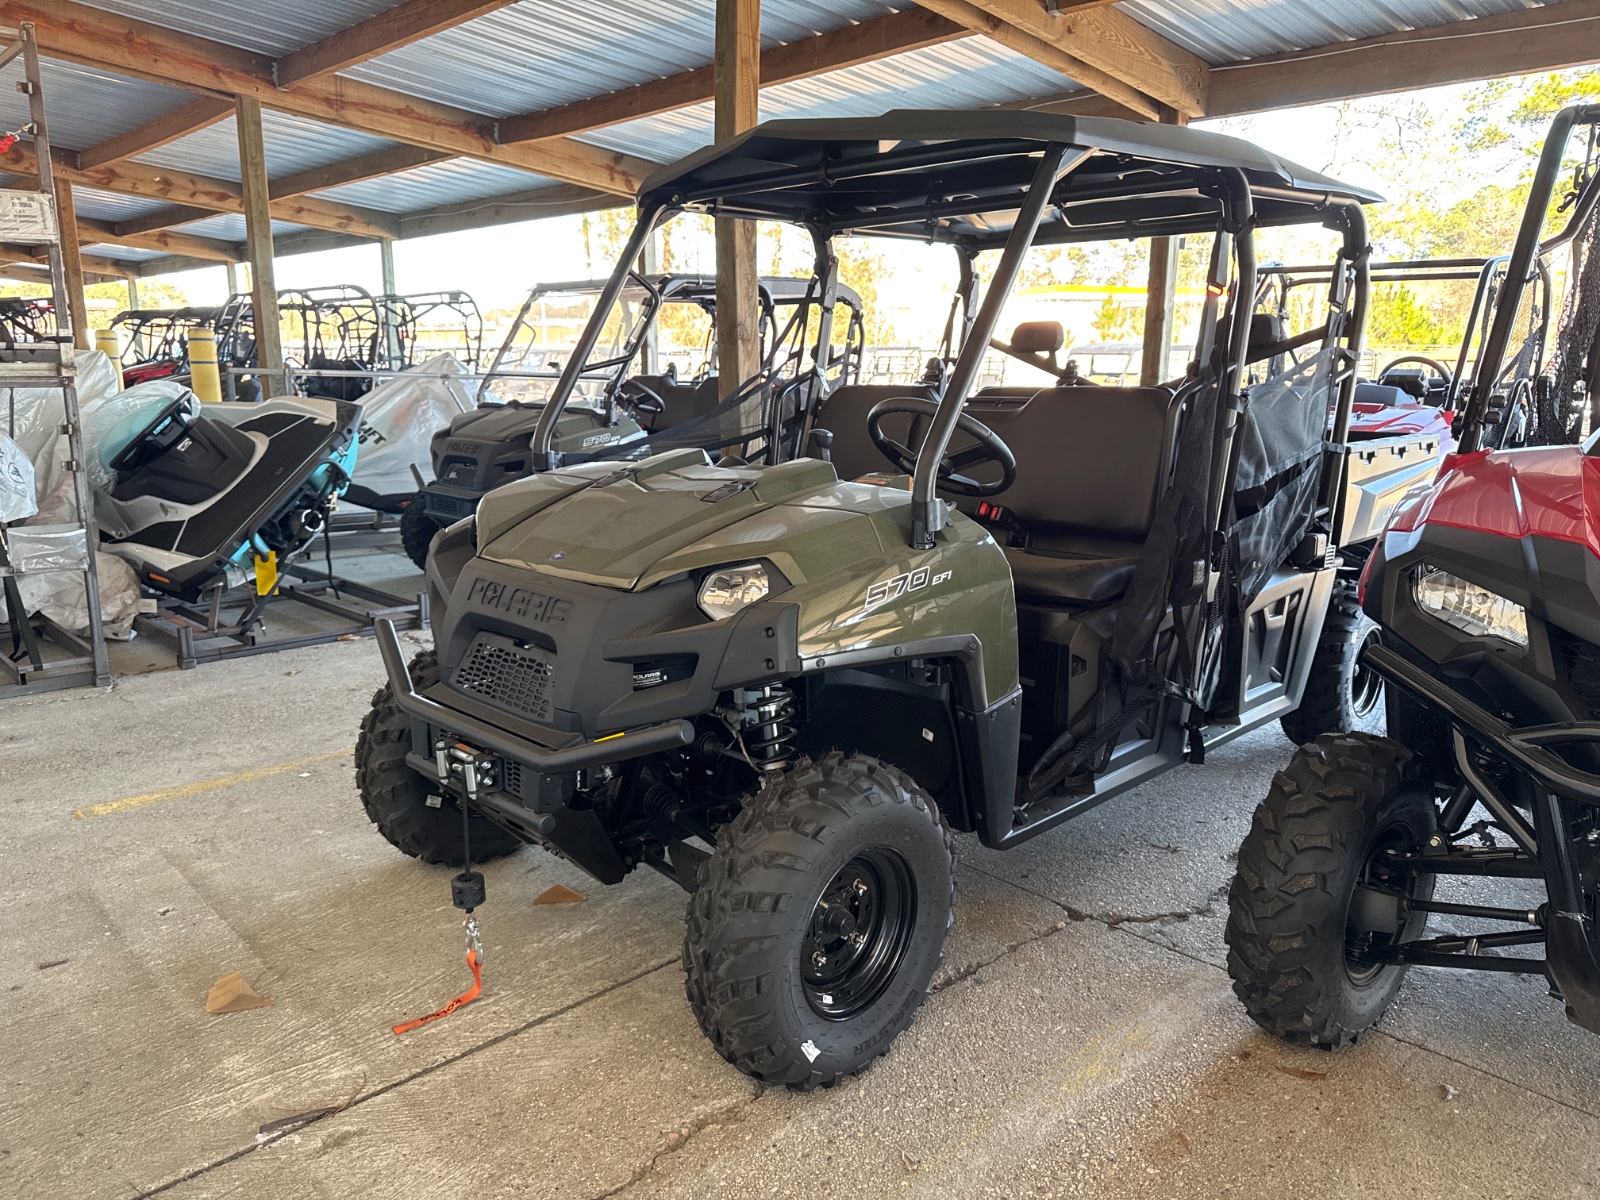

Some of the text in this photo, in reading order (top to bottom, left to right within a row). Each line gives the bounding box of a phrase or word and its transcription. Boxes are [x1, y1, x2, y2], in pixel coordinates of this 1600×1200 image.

[583, 433, 611, 447] 570
[467, 577, 573, 626] POLARIS
[864, 566, 952, 609] 570 EFI
[852, 988, 918, 1057] CARLSTAR
